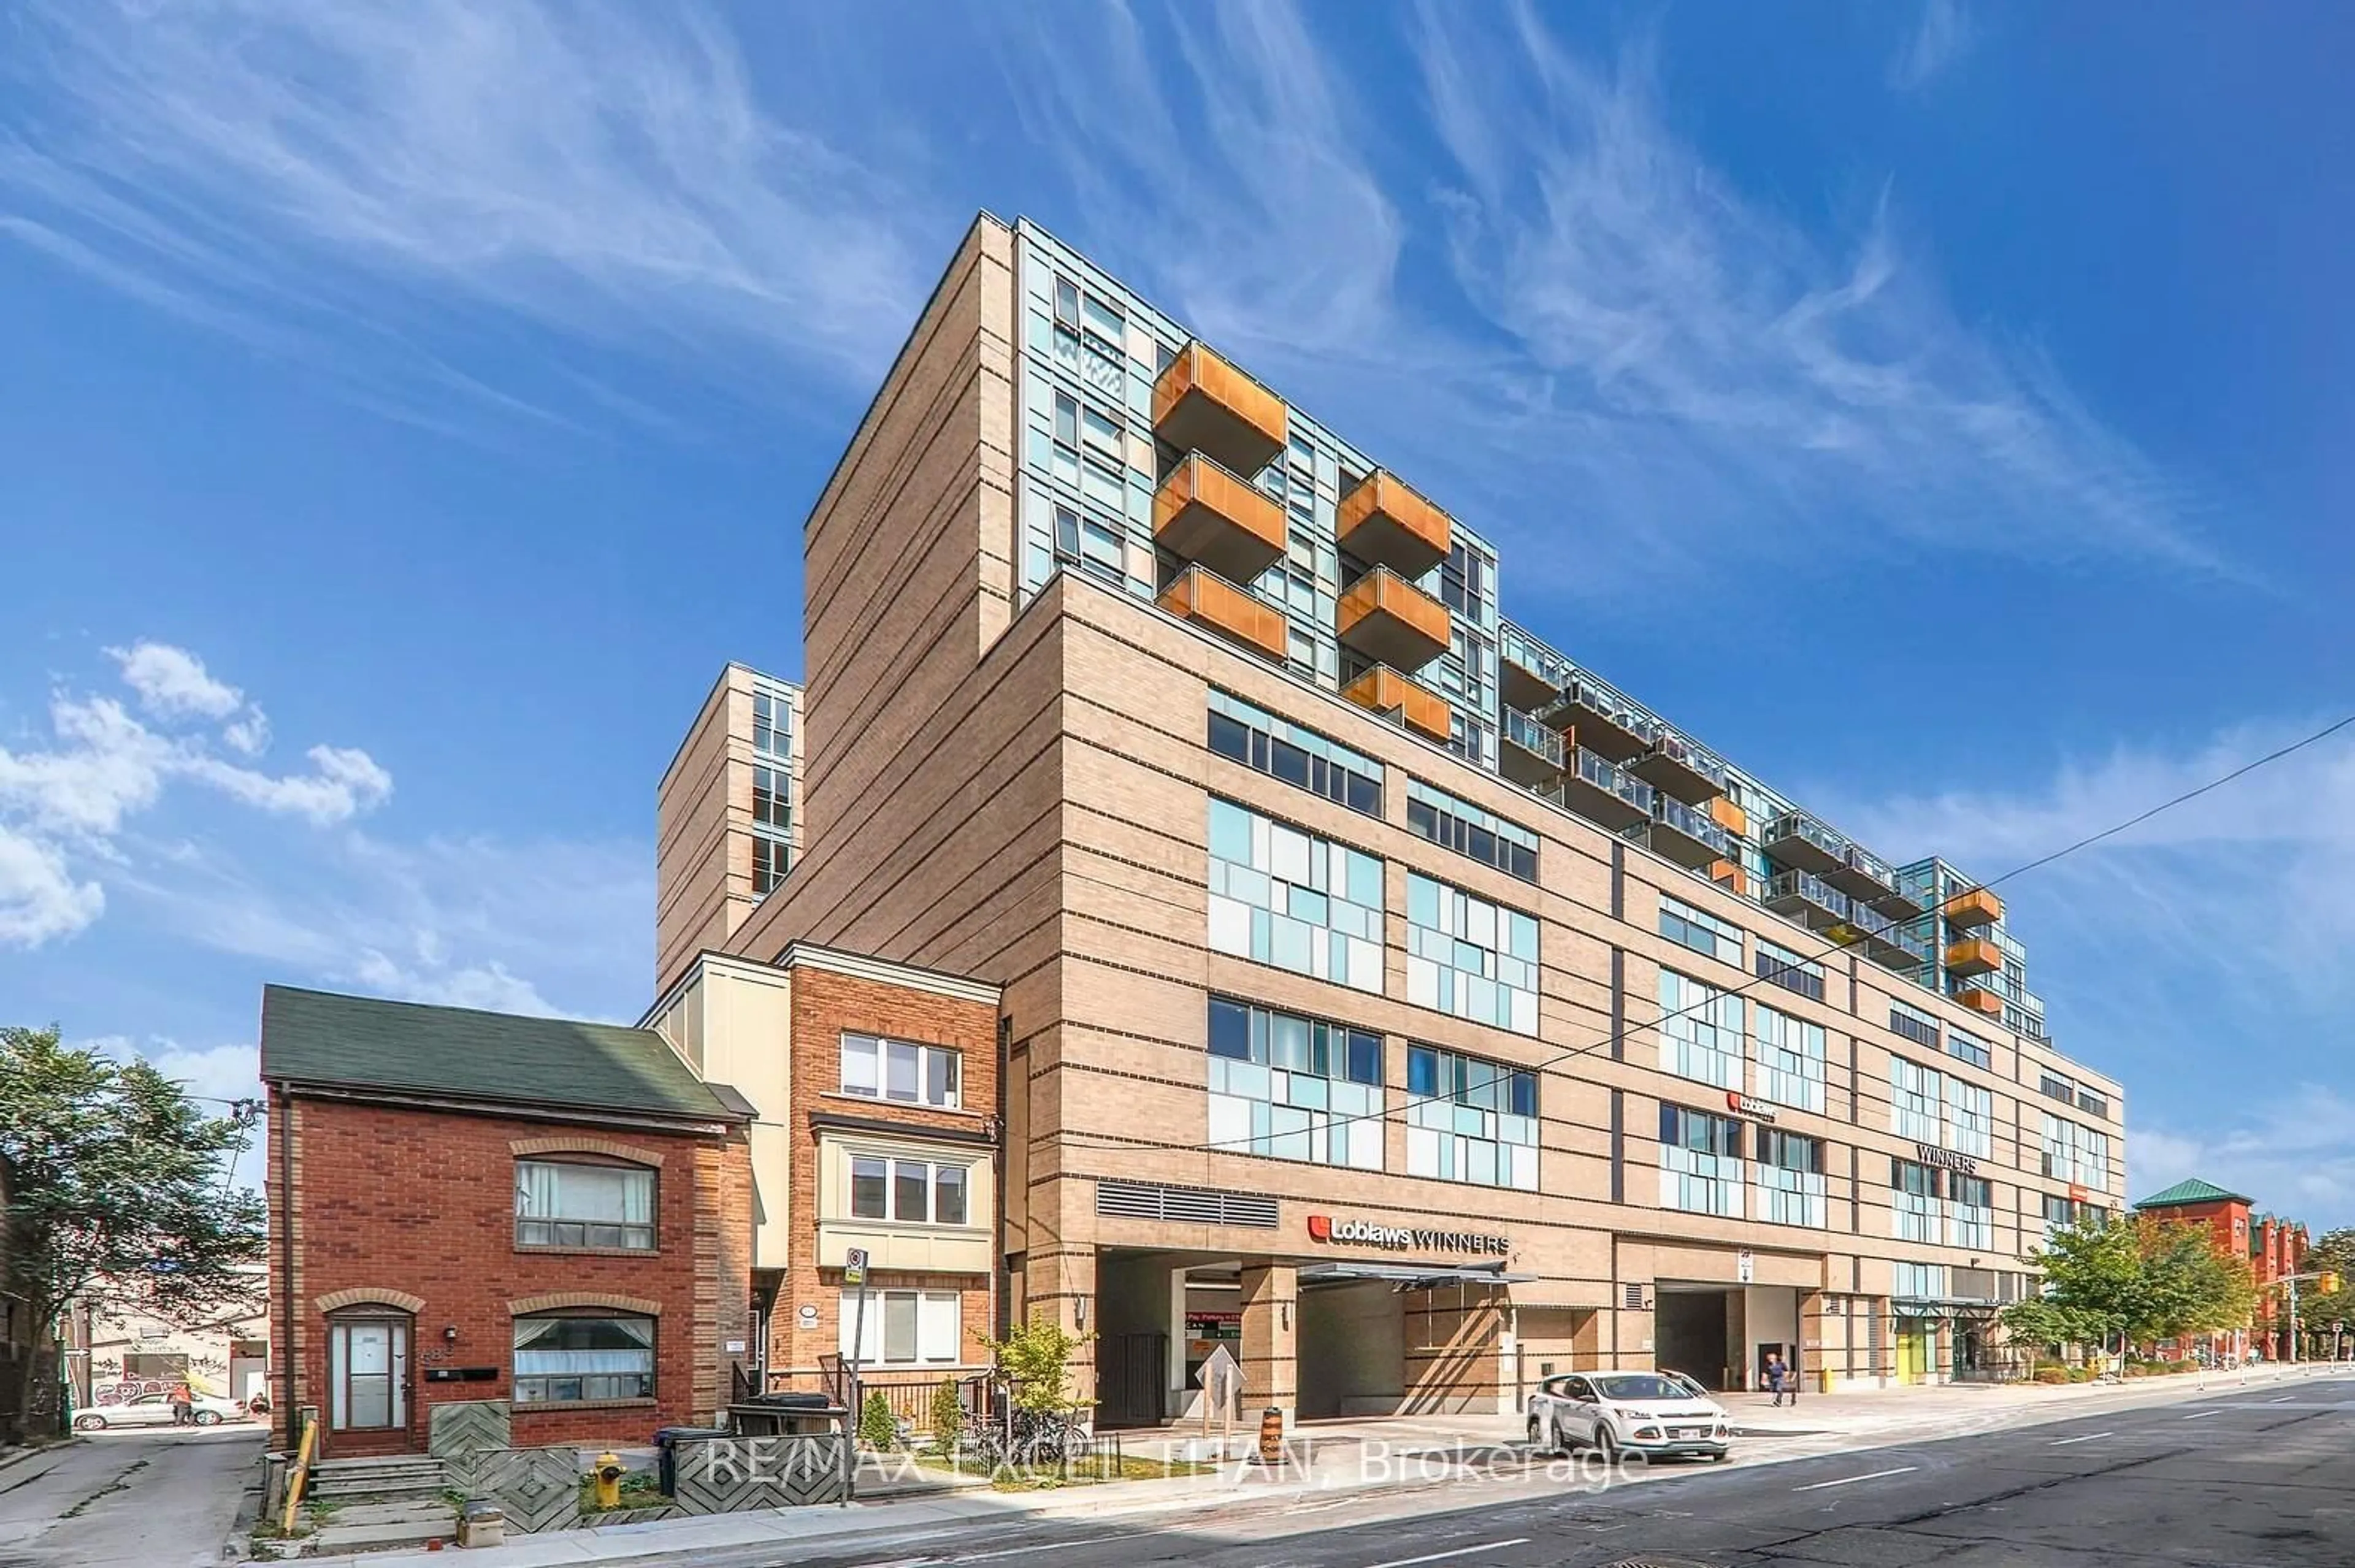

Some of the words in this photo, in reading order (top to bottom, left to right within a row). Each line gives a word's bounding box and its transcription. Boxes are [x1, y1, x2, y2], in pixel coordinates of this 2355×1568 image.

[1917, 1144, 1978, 1174] WINNERS
[1331, 1217, 1411, 1244] Loblaws
[1414, 1229, 1512, 1252] WINNERS
